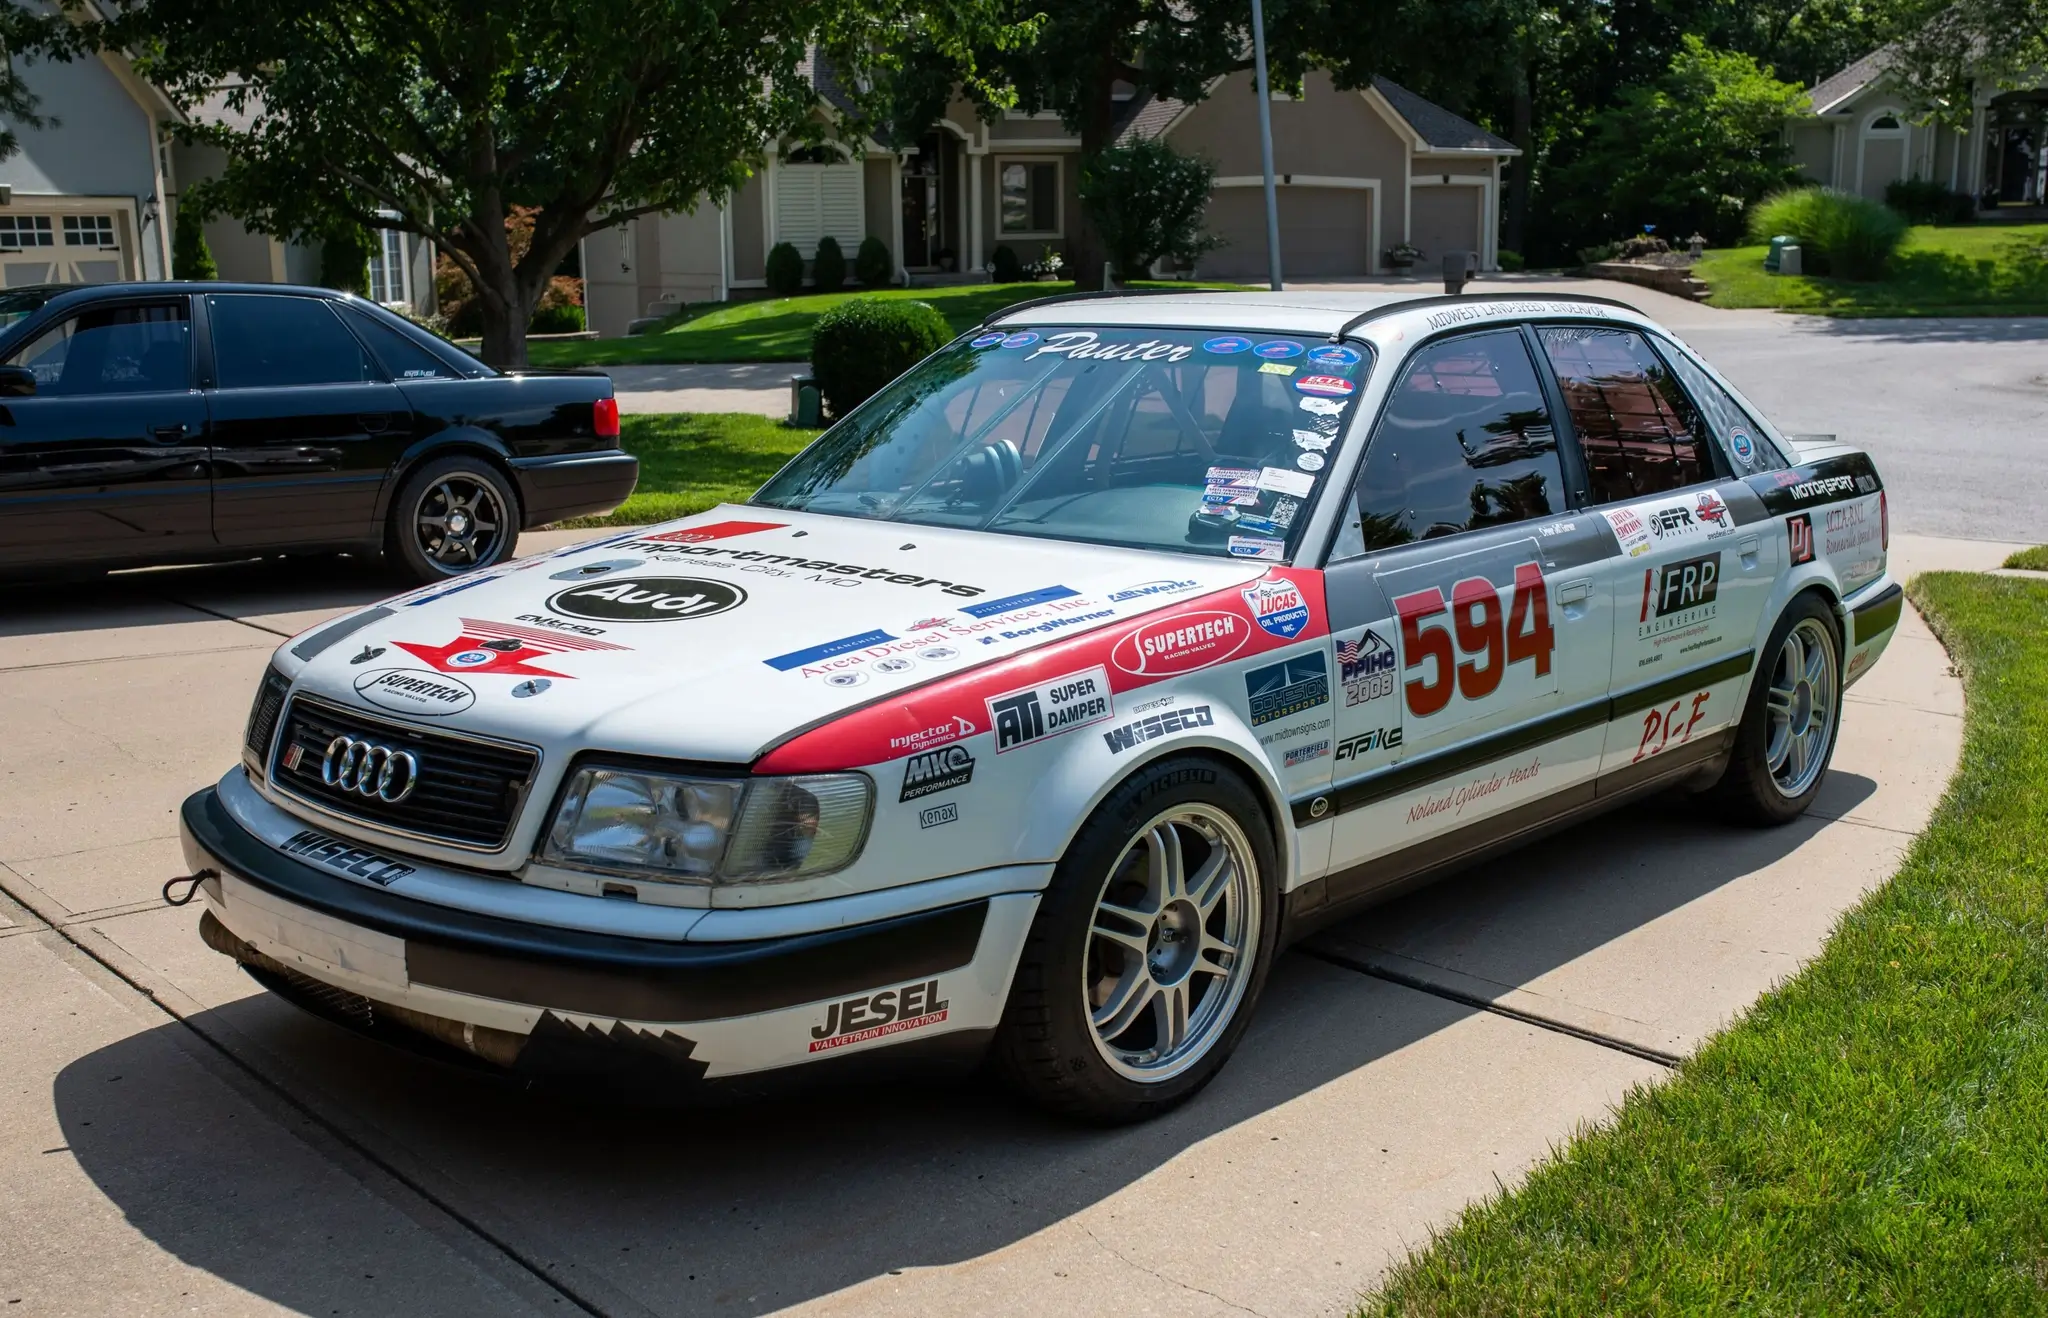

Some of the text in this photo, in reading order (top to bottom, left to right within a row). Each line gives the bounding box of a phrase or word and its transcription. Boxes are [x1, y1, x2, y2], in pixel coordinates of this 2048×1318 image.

[1426, 302, 1609, 330] MIDWEST LAND-SPEED ENDEAVOR
[1024, 332, 1193, 362] Pauter
[1789, 475, 1854, 500] MOTORSPORT
[1615, 518, 1643, 538] EDITION
[1659, 506, 1696, 530] EFR
[604, 538, 986, 598] Importmasters
[646, 554, 862, 588] Kansas City, MO
[569, 583, 721, 615] Audi
[1662, 561, 1716, 610] FRP
[975, 597, 1037, 615] DISTRIBUTOR
[1260, 592, 1298, 615] LUCAS
[1261, 609, 1307, 627] OIL PRODUCTS
[1001, 608, 1117, 641] BorgWarner
[1638, 605, 1717, 636] ENGINEERING
[800, 599, 1098, 679] Area Diesel Service, Inc.
[822, 635, 883, 654] FRANCHISE
[1144, 616, 1235, 656] SUPERTECH
[1391, 560, 1556, 718] 594
[1164, 642, 1216, 660] RACING VALVES
[379, 674, 470, 703] SUPERTECH
[383, 688, 427, 703] RACING VALVES
[1050, 678, 1097, 704] SUPER
[1250, 678, 1328, 715] COHESION
[1345, 674, 1394, 707] 2008
[992, 690, 1044, 748] ATI
[1047, 697, 1107, 730] DAMPER
[1252, 694, 1329, 726] MOTORSPORTS
[890, 722, 953, 748] Injector
[911, 732, 956, 750] Dynamics
[1259, 718, 1331, 747] www.midtownsigns.com
[1285, 741, 1329, 760] PORTERFIELD
[903, 773, 969, 799] PERFORMANCE
[1405, 756, 1542, 825] Noland Cylinder Heads
[919, 806, 956, 825] Kenax
[811, 979, 950, 1039] JESEL
[813, 1013, 944, 1051] VALVETRAIN INNOVATION
